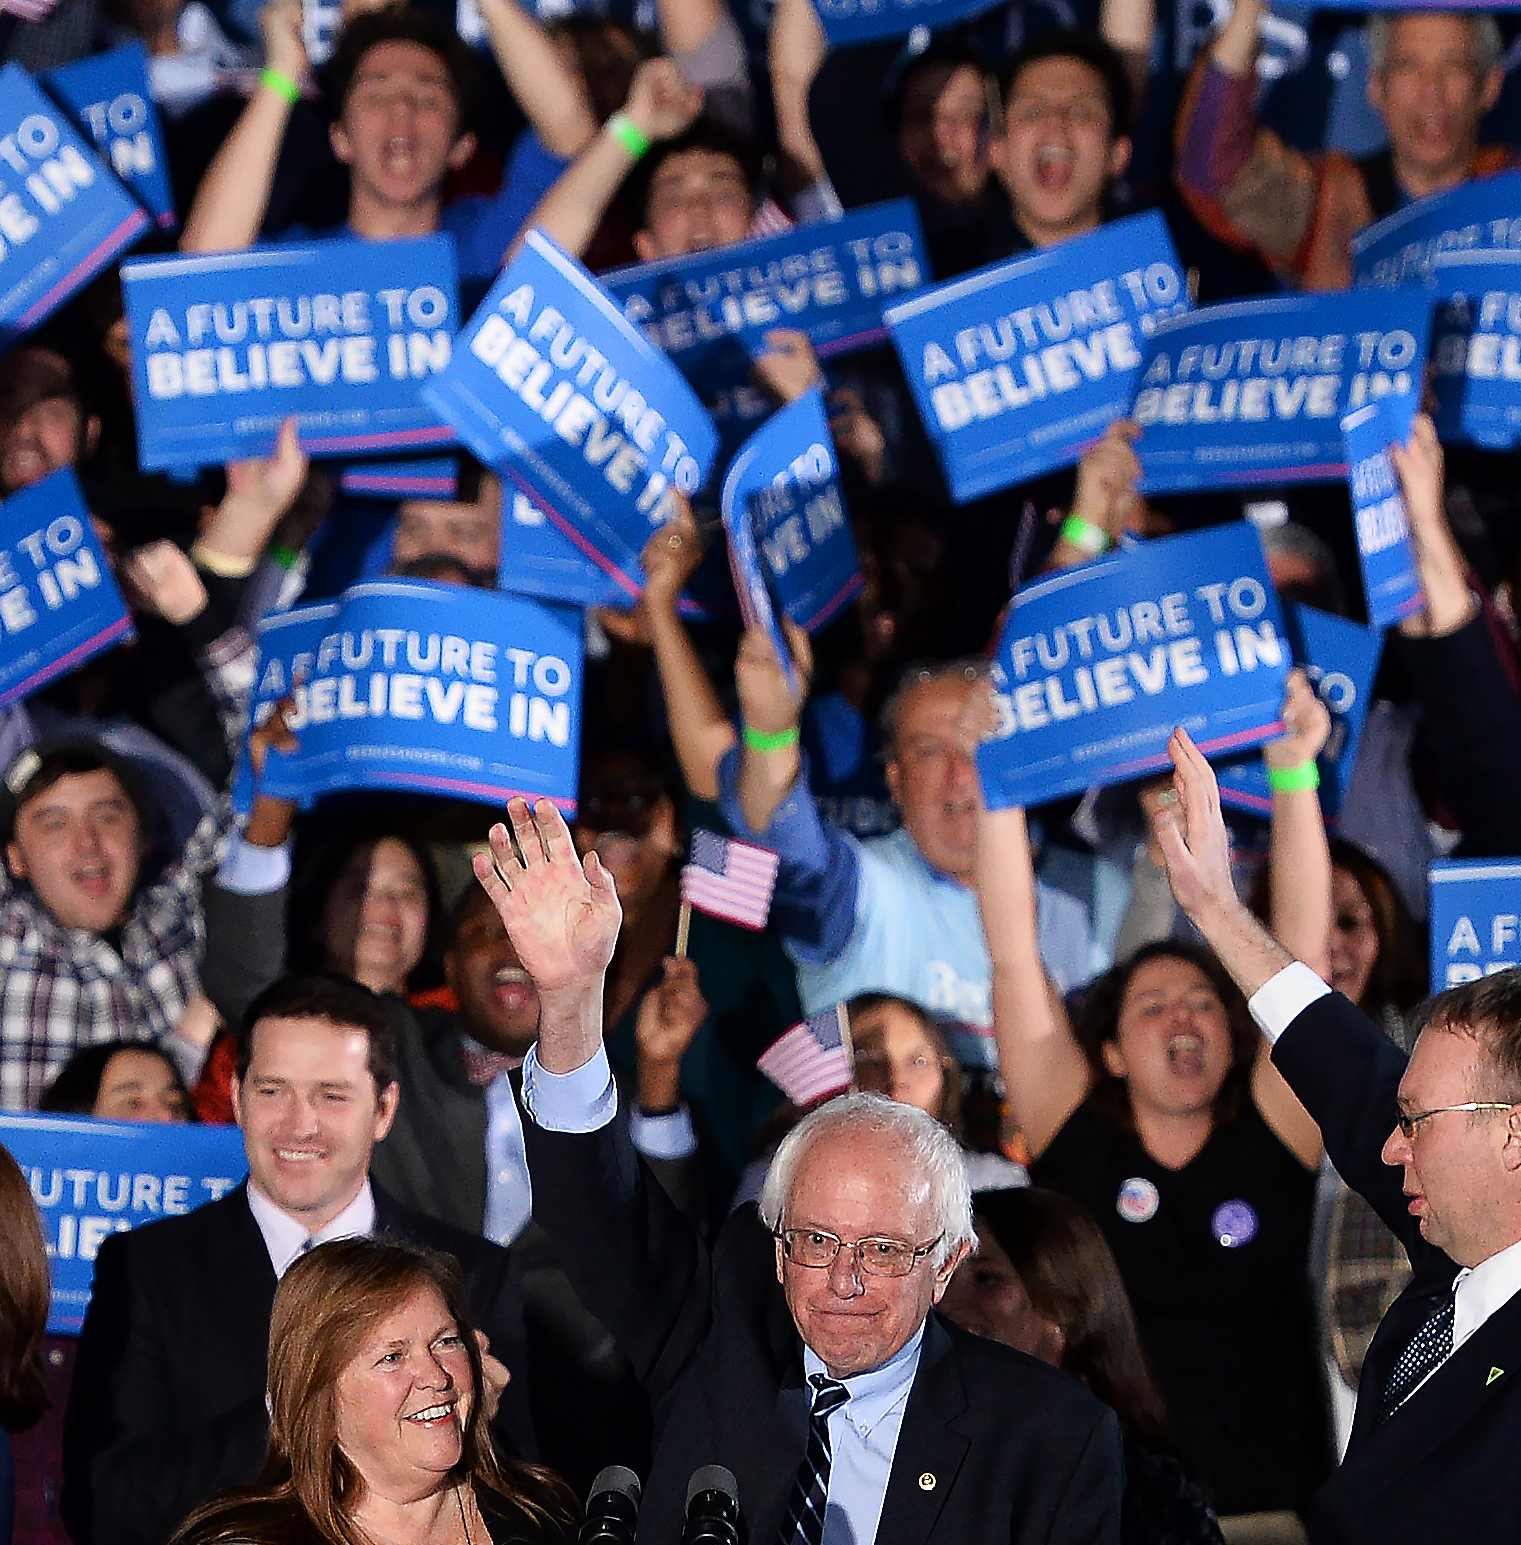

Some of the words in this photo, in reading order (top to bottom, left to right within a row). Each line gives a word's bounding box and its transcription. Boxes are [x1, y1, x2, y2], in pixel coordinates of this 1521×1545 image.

[80, 92, 148, 142] TO
[24, 142, 97, 215] IN
[662, 248, 833, 313] FUTURE
[841, 231, 916, 269] TO
[855, 258, 922, 295] IN
[146, 307, 192, 348] A
[186, 299, 372, 342] FUTURE
[377, 285, 450, 328] TO
[922, 341, 957, 383] A
[955, 279, 1126, 370] FUTURE
[1121, 261, 1183, 303] TO
[144, 335, 376, 400] BELIEVE
[388, 332, 453, 378] IN
[499, 283, 536, 327] A
[527, 305, 665, 453] FUTURE
[660, 427, 702, 493] TO
[928, 324, 1143, 432] BELIEVE
[1140, 353, 1172, 389] A
[1177, 334, 1347, 382] FUTURE
[1355, 328, 1419, 370] TO
[469, 312, 647, 493] BELIEVE
[1133, 376, 1342, 426] BELIEVE
[17, 513, 86, 571] TO
[35, 547, 104, 611] IN
[1010, 592, 1192, 675] FUTURE
[1196, 576, 1268, 622] TO
[317, 628, 496, 684] FUTURE
[504, 646, 573, 700] TO
[988, 637, 1209, 740] BELIEVE
[1218, 621, 1284, 676] IN
[508, 693, 571, 749] IN
[1446, 914, 1482, 956] A
